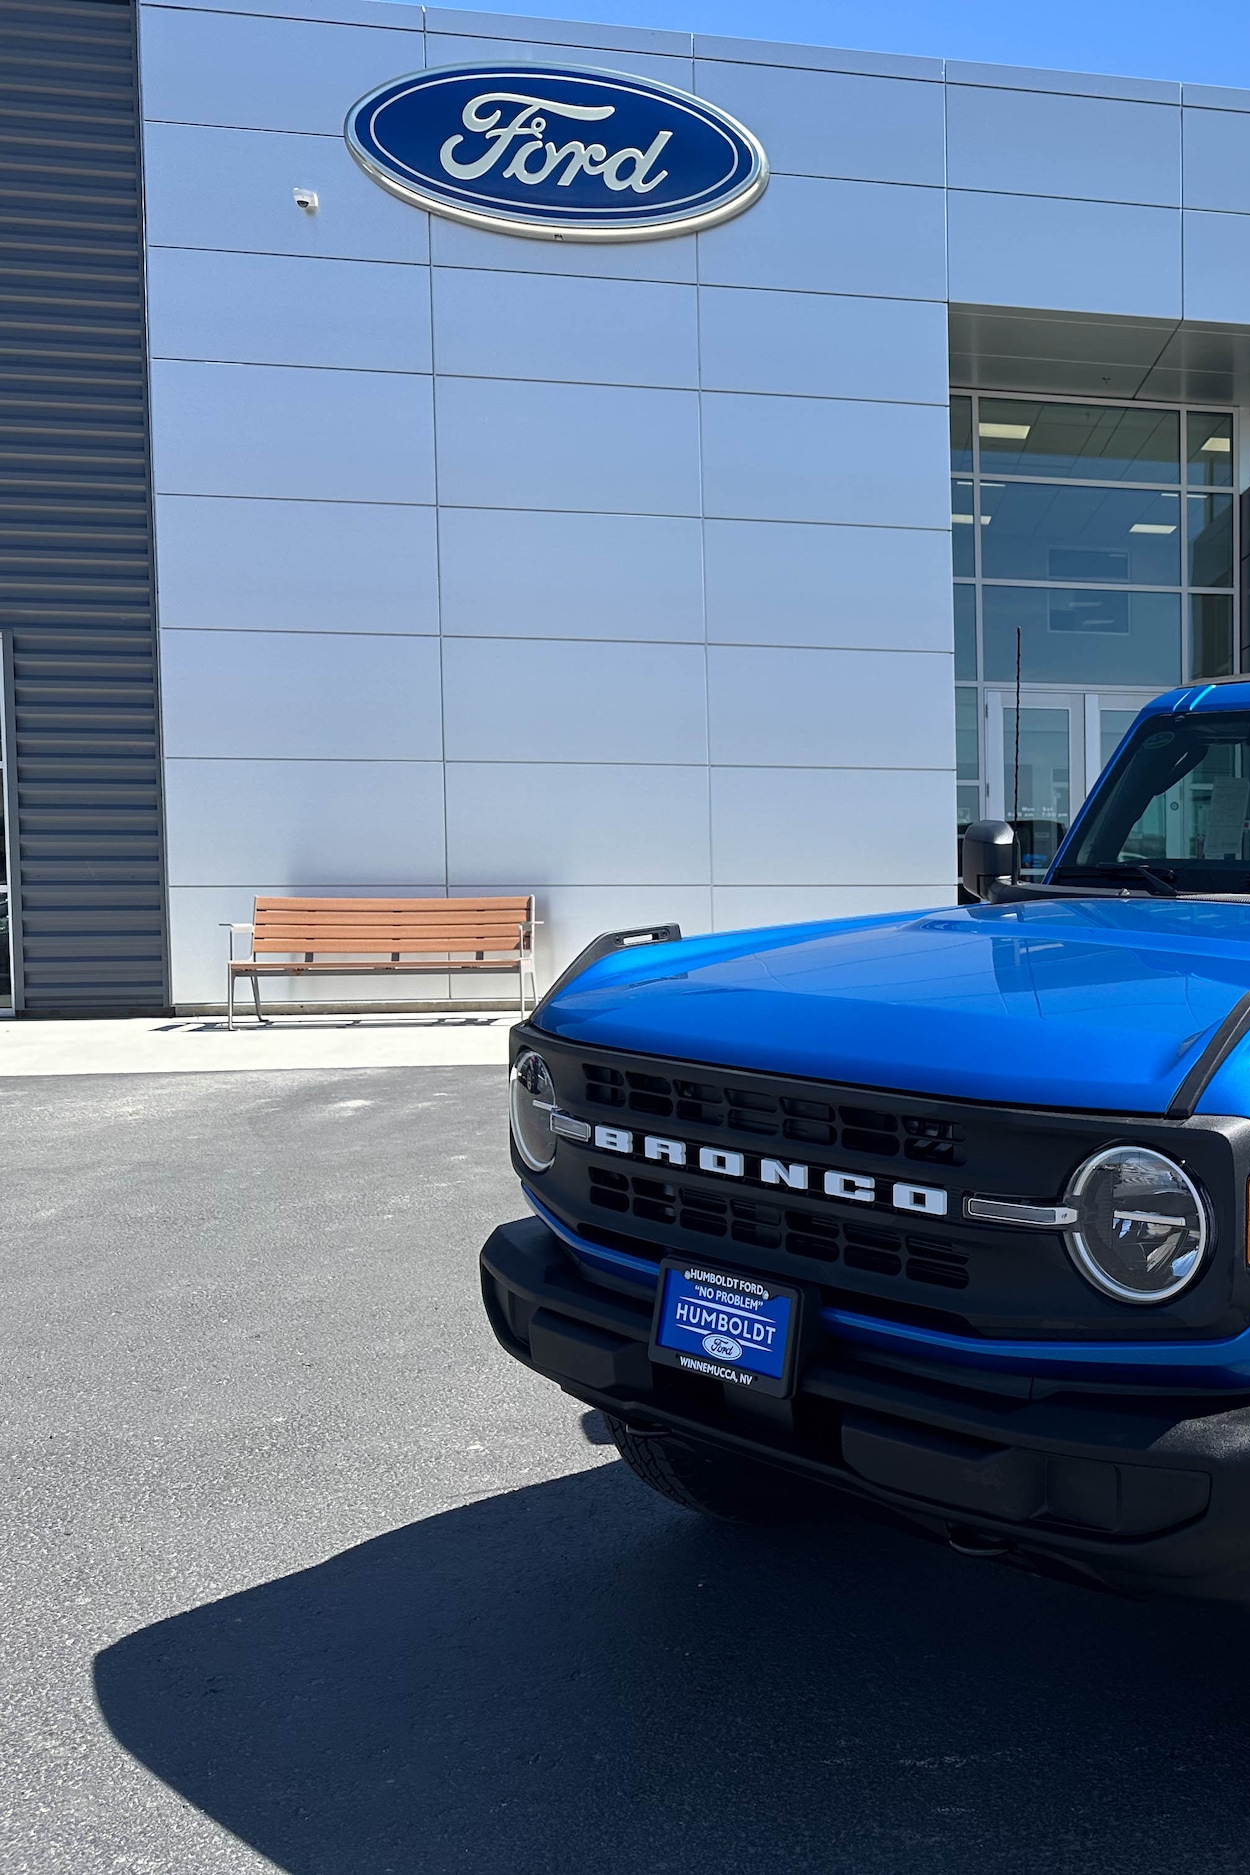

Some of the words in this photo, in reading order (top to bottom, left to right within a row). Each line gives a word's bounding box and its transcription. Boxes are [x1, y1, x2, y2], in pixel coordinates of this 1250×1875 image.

[439, 92, 674, 195] Ford
[593, 1124, 949, 1216] BRONCO
[690, 1268, 739, 1290] HUMBOLDT
[739, 1280, 764, 1296] FORD
[675, 1302, 776, 1345] HUMBOLDT
[710, 1338, 734, 1357] Ford
[679, 1355, 739, 1384] WINNEMUCCA,
[739, 1373, 753, 1386] NV
